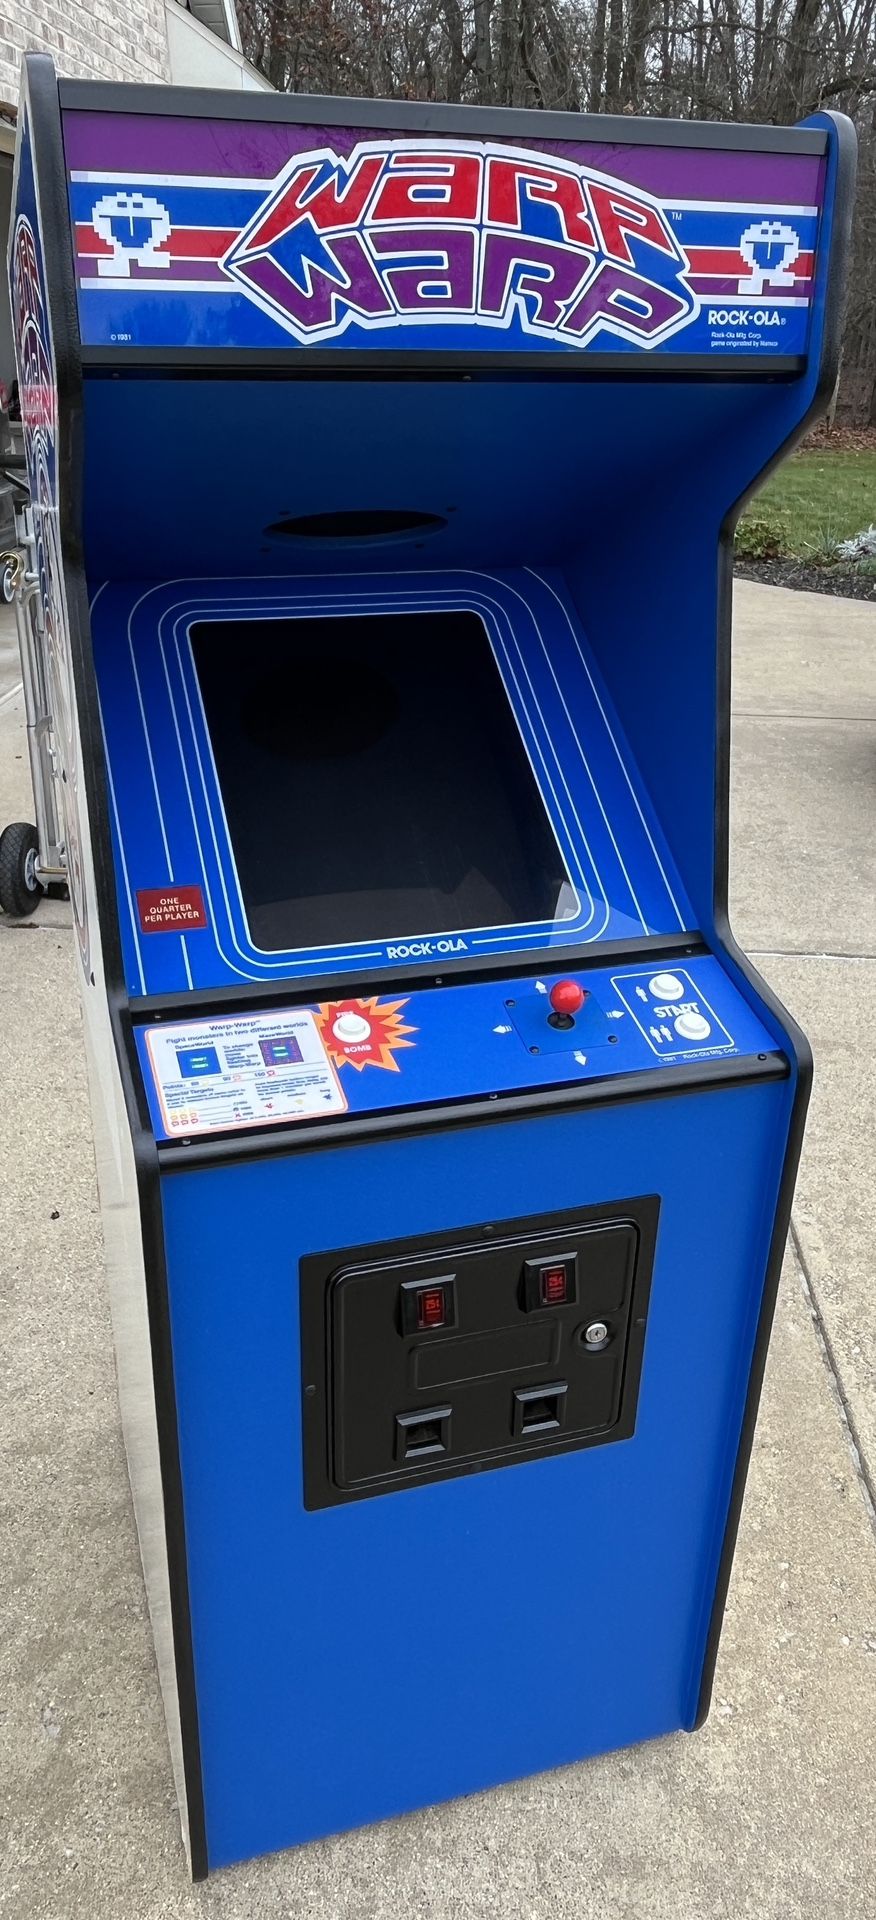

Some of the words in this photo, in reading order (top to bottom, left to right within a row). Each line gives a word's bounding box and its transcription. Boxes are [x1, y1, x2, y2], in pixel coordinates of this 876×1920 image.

[160, 896, 180, 905] ONE
[149, 903, 192, 915] QUARTER
[144, 913, 163, 923] PER
[164, 910, 200, 921] PLAYER
[386, 938, 469, 959] ROCK-OLA
[653, 1002, 700, 1018] START
[343, 1044, 372, 1054] BOMB
